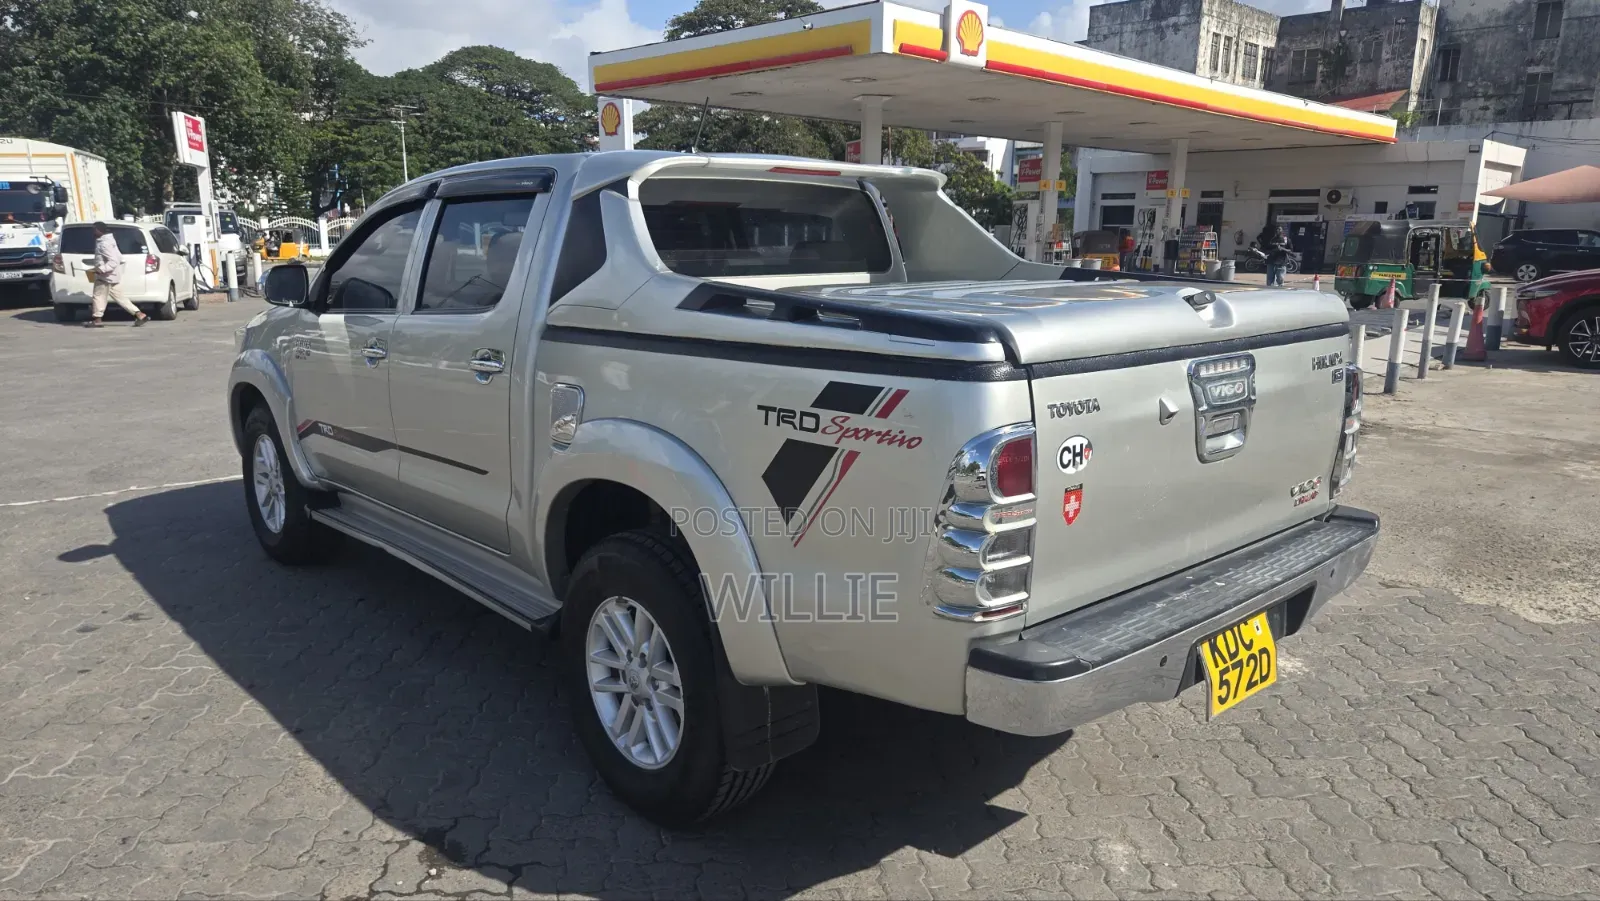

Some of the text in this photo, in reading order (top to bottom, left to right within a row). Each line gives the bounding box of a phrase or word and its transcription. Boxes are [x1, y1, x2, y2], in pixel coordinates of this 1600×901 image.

[1312, 351, 1343, 371] HILUX
[1210, 382, 1244, 397] VIGO
[1047, 398, 1100, 419] TOYOTA
[318, 423, 334, 436] TRD
[757, 404, 923, 450] TRD Sportivo
[1059, 443, 1084, 469] CH
[1208, 620, 1254, 669] KDC
[1217, 647, 1271, 705] 572D
